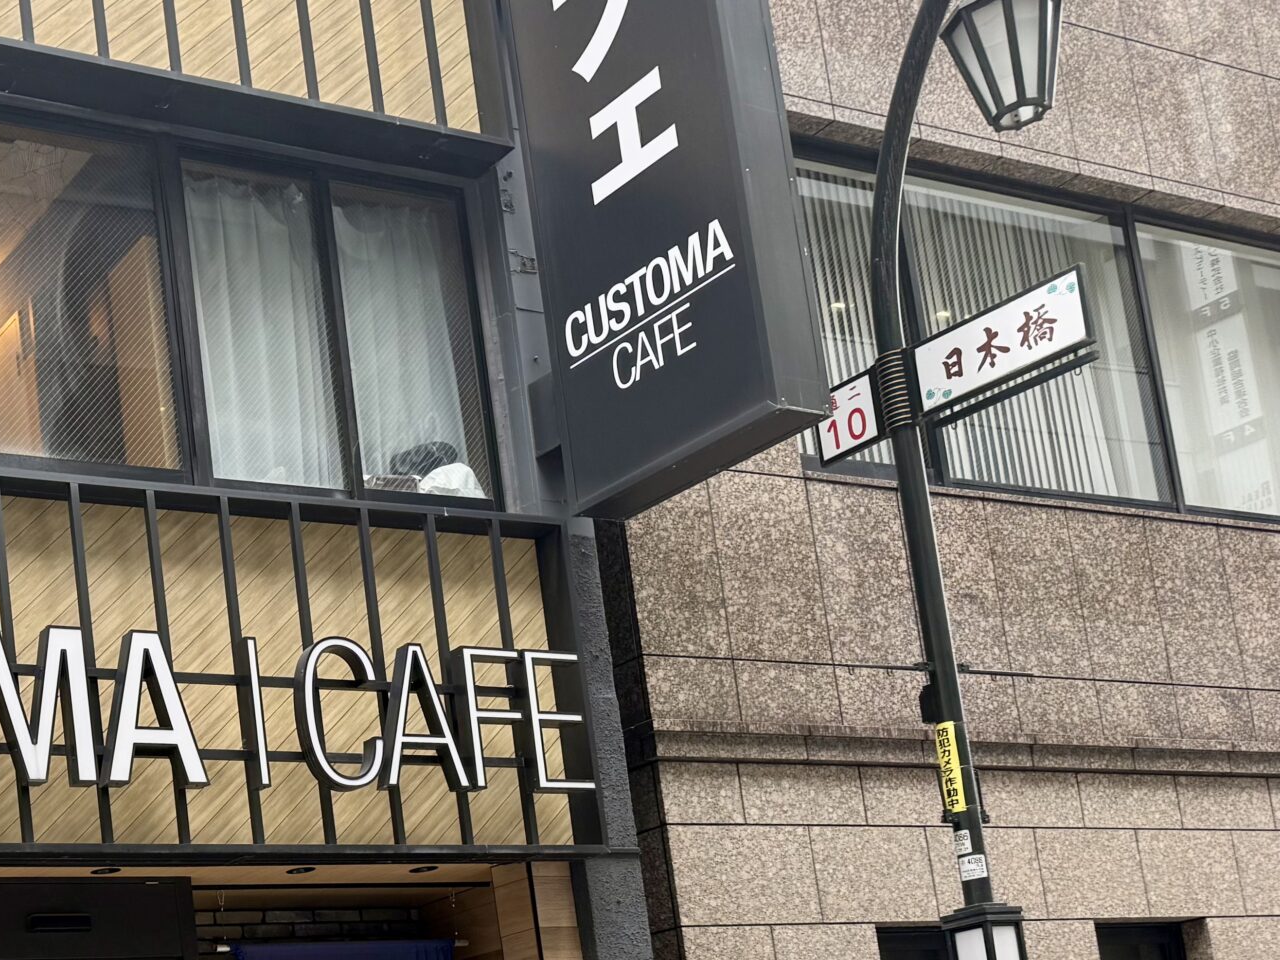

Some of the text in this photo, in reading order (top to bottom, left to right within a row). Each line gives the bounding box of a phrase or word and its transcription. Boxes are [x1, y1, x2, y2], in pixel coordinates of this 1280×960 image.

[565, 218, 734, 358] CUSTOMA
[612, 303, 697, 389] CAFE
[942, 304, 1058, 379] 日本橋
[827, 408, 867, 450] 10
[294, 636, 596, 794] CAFE
[936, 727, 959, 808] 防犯カメラ作動中
